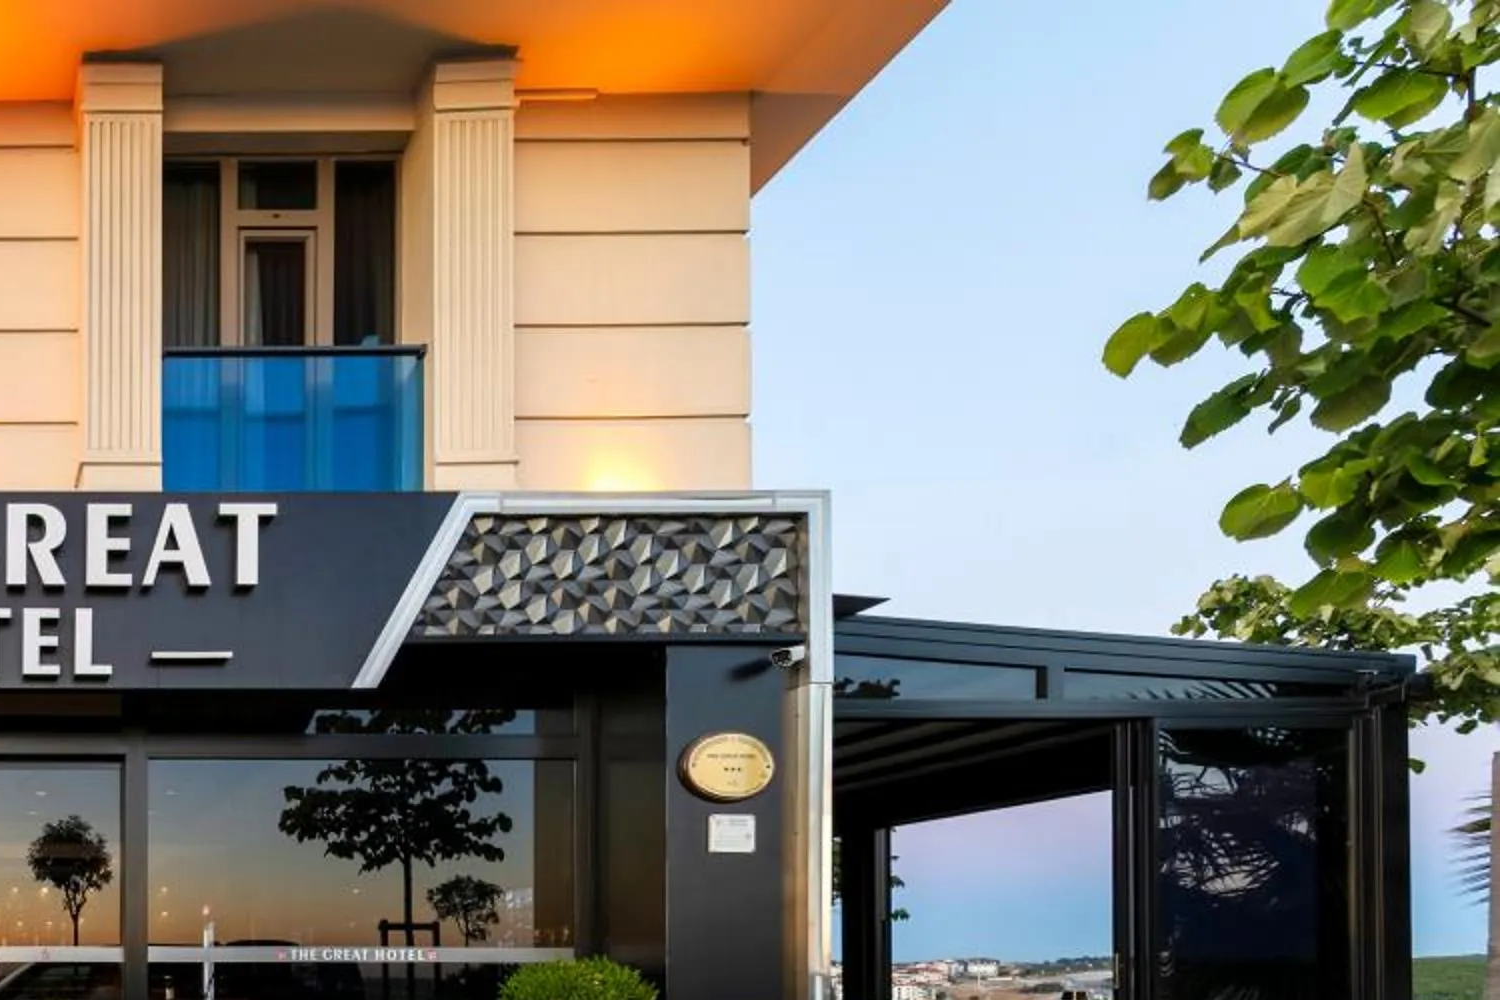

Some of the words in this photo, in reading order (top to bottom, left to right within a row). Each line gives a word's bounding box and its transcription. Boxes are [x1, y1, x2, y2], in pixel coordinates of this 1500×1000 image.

[291, 948, 316, 961] THE
[322, 948, 368, 961] GREAT
[375, 949, 425, 961] HOTEL
